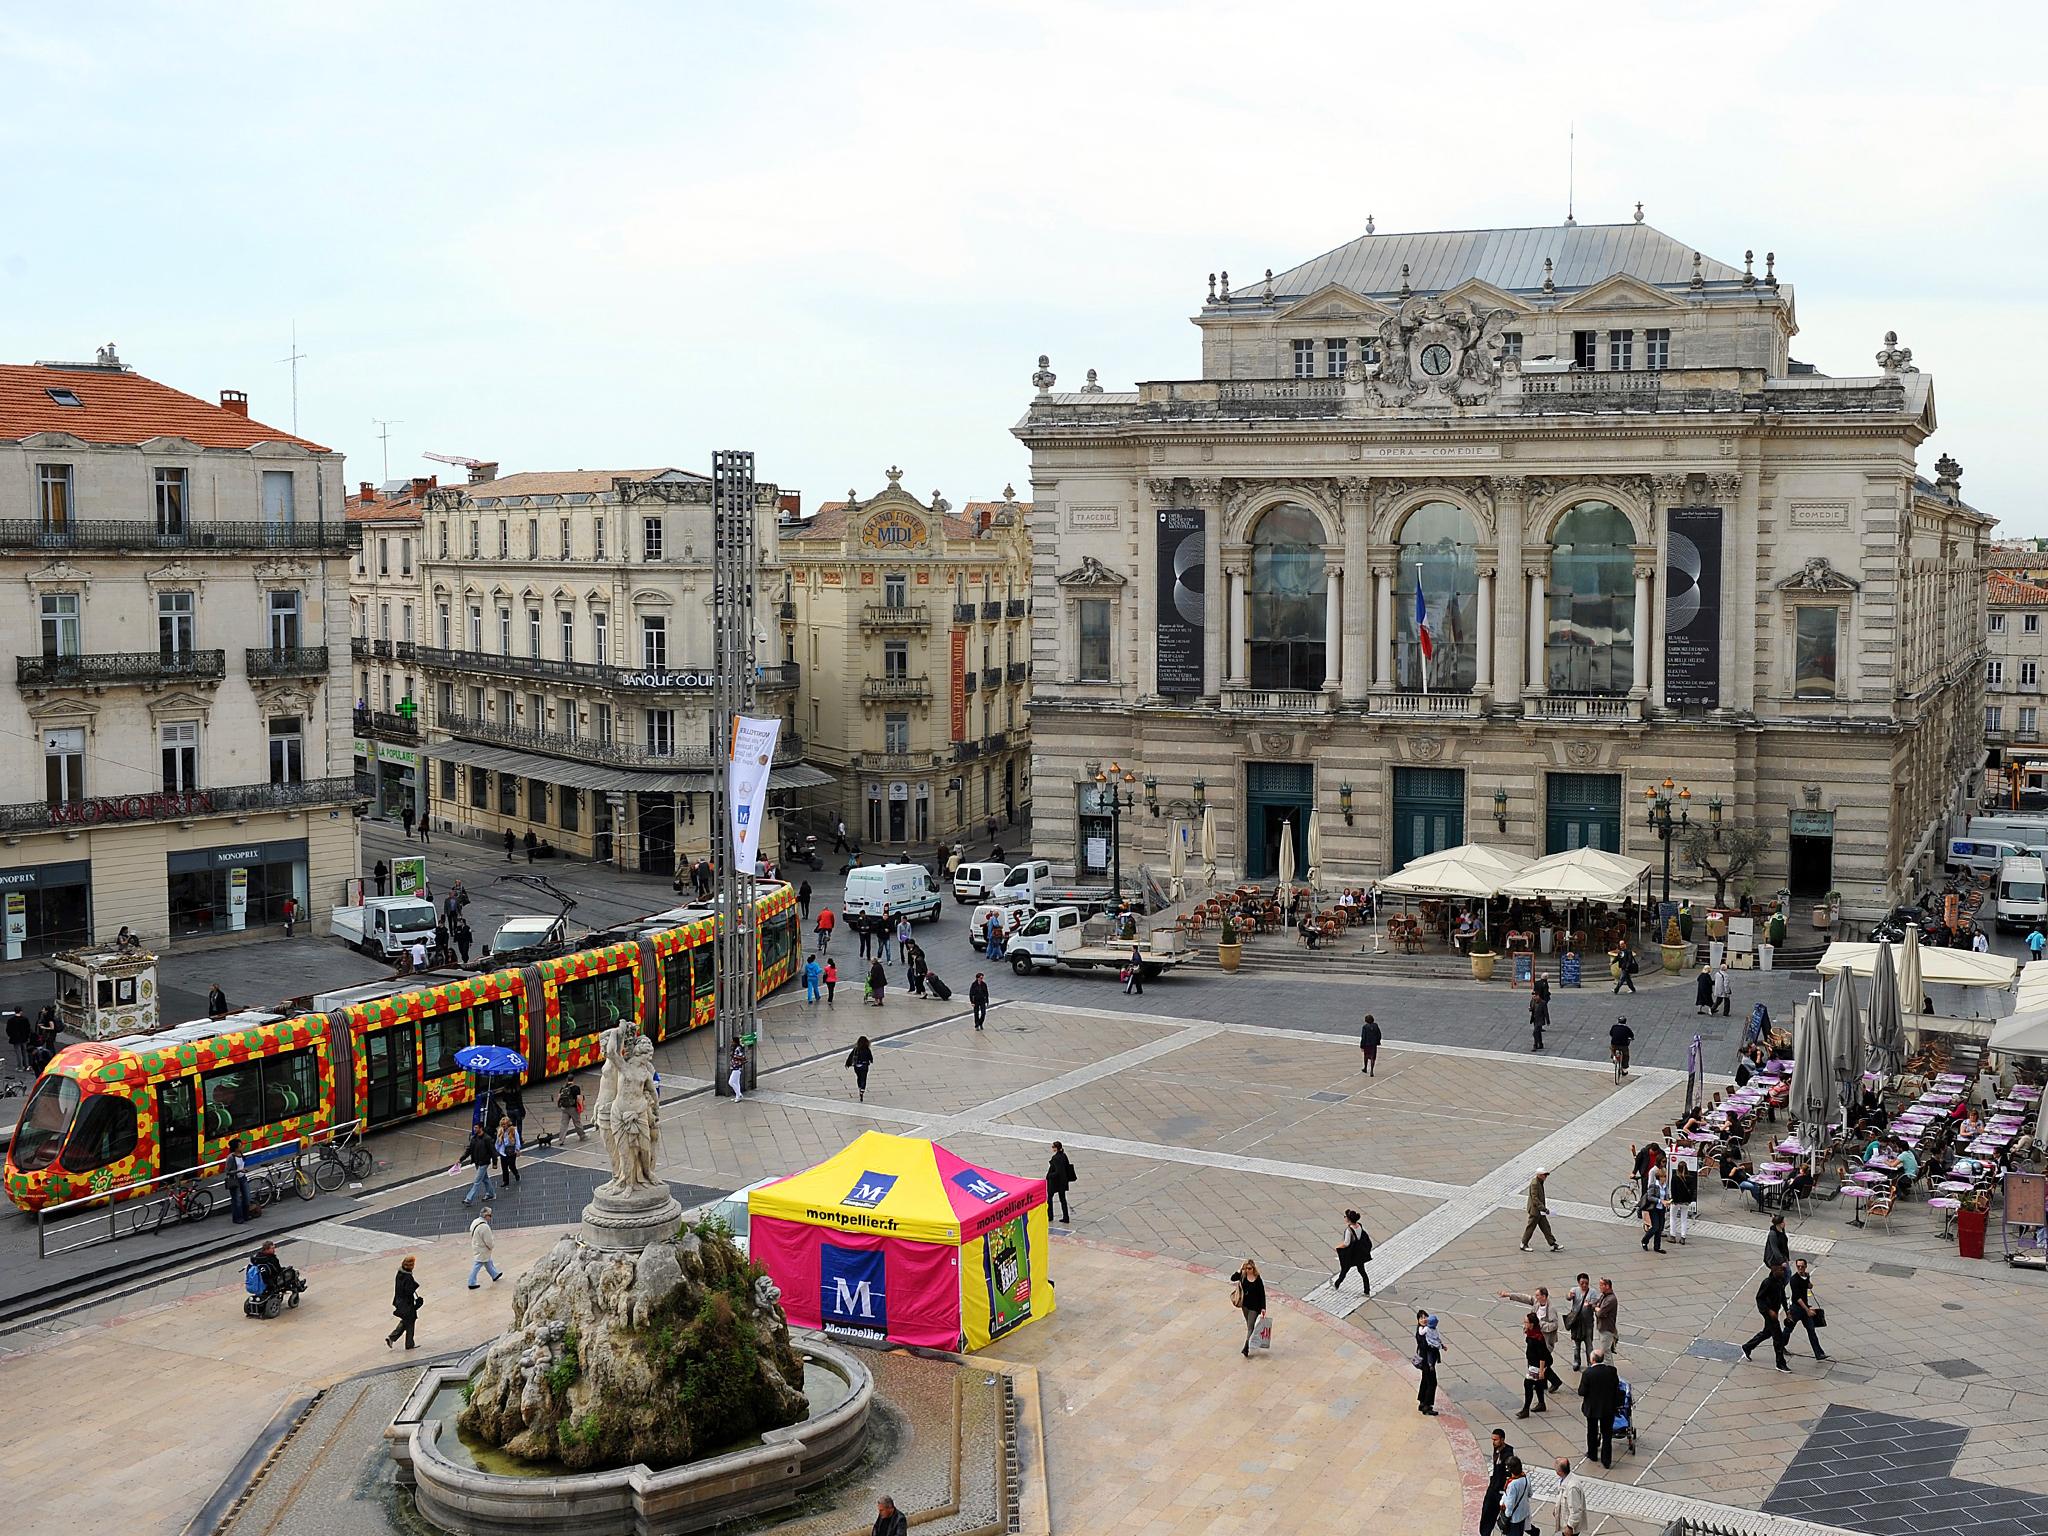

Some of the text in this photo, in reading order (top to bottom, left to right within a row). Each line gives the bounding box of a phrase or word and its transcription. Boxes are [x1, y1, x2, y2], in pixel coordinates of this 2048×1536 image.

[1379, 448, 1415, 456] OPERA
[1432, 447, 1483, 455] COMEDIE
[864, 511, 922, 536] GRAND HOTEL
[1799, 511, 1840, 519] COMEDIE
[877, 527, 912, 542] MIDI
[623, 673, 675, 688] BANQUE
[953, 640, 963, 731] NEW HOTEL DU MIDI
[379, 746, 385, 757] LA
[386, 748, 414, 762] POPULAIRE
[50, 791, 214, 825] MONOPRIX
[218, 850, 258, 861] MONOPRIX
[858, 1183, 884, 1201] M
[968, 1179, 997, 1197] M
[806, 1208, 899, 1231] montpellier.fr
[976, 1193, 1034, 1231] montpellier.fr
[833, 1276, 876, 1318] M
[824, 1322, 886, 1341] Montpellier
